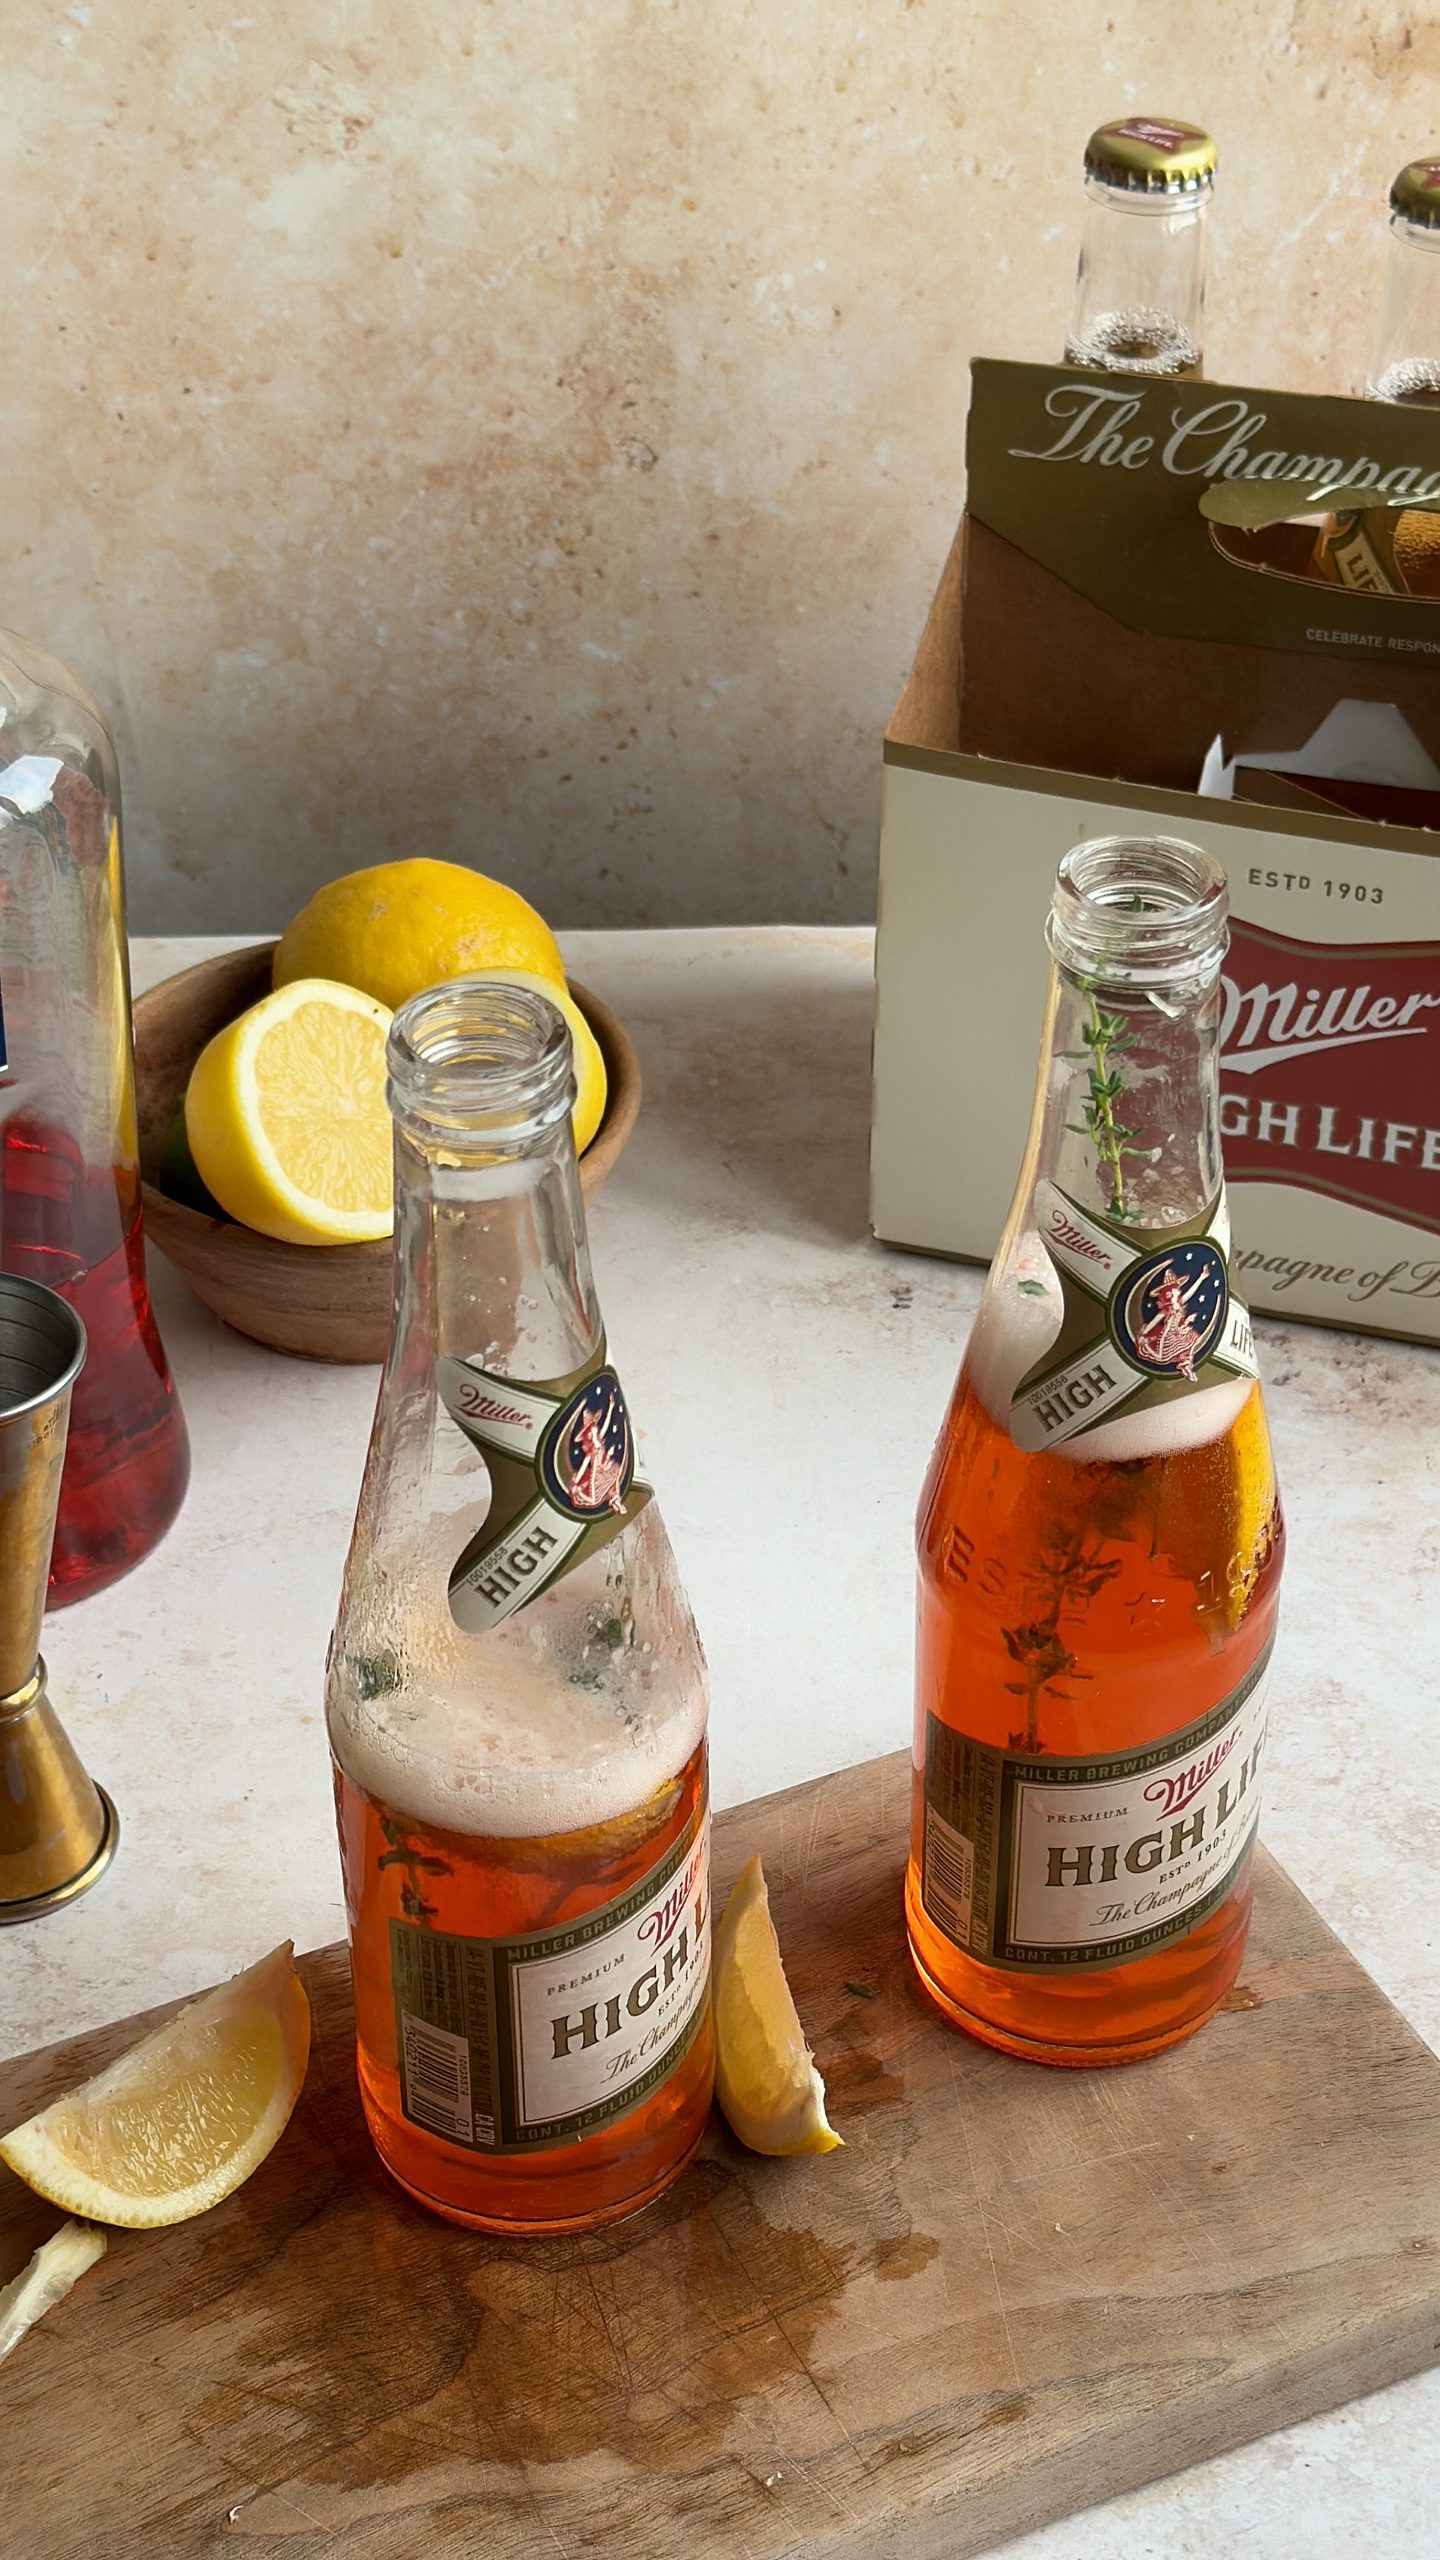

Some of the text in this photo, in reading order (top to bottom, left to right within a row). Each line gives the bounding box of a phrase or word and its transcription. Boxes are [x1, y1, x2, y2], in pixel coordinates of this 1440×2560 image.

[1007, 384, 1155, 469] The
[1306, 628, 1383, 648] CELEBRATE
[1248, 868, 1383, 904] ESTD 1903
[1220, 974, 1440, 1048] Miller
[1219, 1094, 1440, 1171] GH LIFE
[1050, 1209, 1113, 1265] Miller
[1236, 1249, 1355, 1291] pagne
[1347, 1261, 1409, 1302] of
[457, 1383, 533, 1427] Miller
[1033, 1363, 1117, 1433] HIGH
[466, 1547, 508, 1587] 10019558
[474, 1526, 558, 1609] HIGH
[1015, 1765, 1079, 1781] MILLER
[1086, 1752, 1168, 1781] BREWING
[1143, 1723, 1241, 1813] Miller
[1044, 1805, 1207, 1887] HIGH
[1213, 1722, 1266, 1830] LIF
[1046, 1807, 1128, 1824] PREMIUM
[1159, 1828, 1227, 1885] ESTD 1903
[637, 1836, 705, 1945] Miller
[1088, 1903, 1131, 1926] The
[1134, 1856, 1223, 1915] Champagne
[507, 1935, 576, 1960] MILLER
[582, 1883, 655, 1940] BREWING
[1005, 1905, 1202, 1963] CONT. 12 FLUID OUNCES
[547, 1953, 625, 1996] PREMIUM
[550, 1925, 689, 2060] HIGH
[601, 2047, 638, 2084] The
[475, 2112, 495, 2128] CA
[516, 2122, 569, 2141] CONT.
[577, 2112, 593, 2127] 12
[600, 2083, 644, 2118] FLUID
